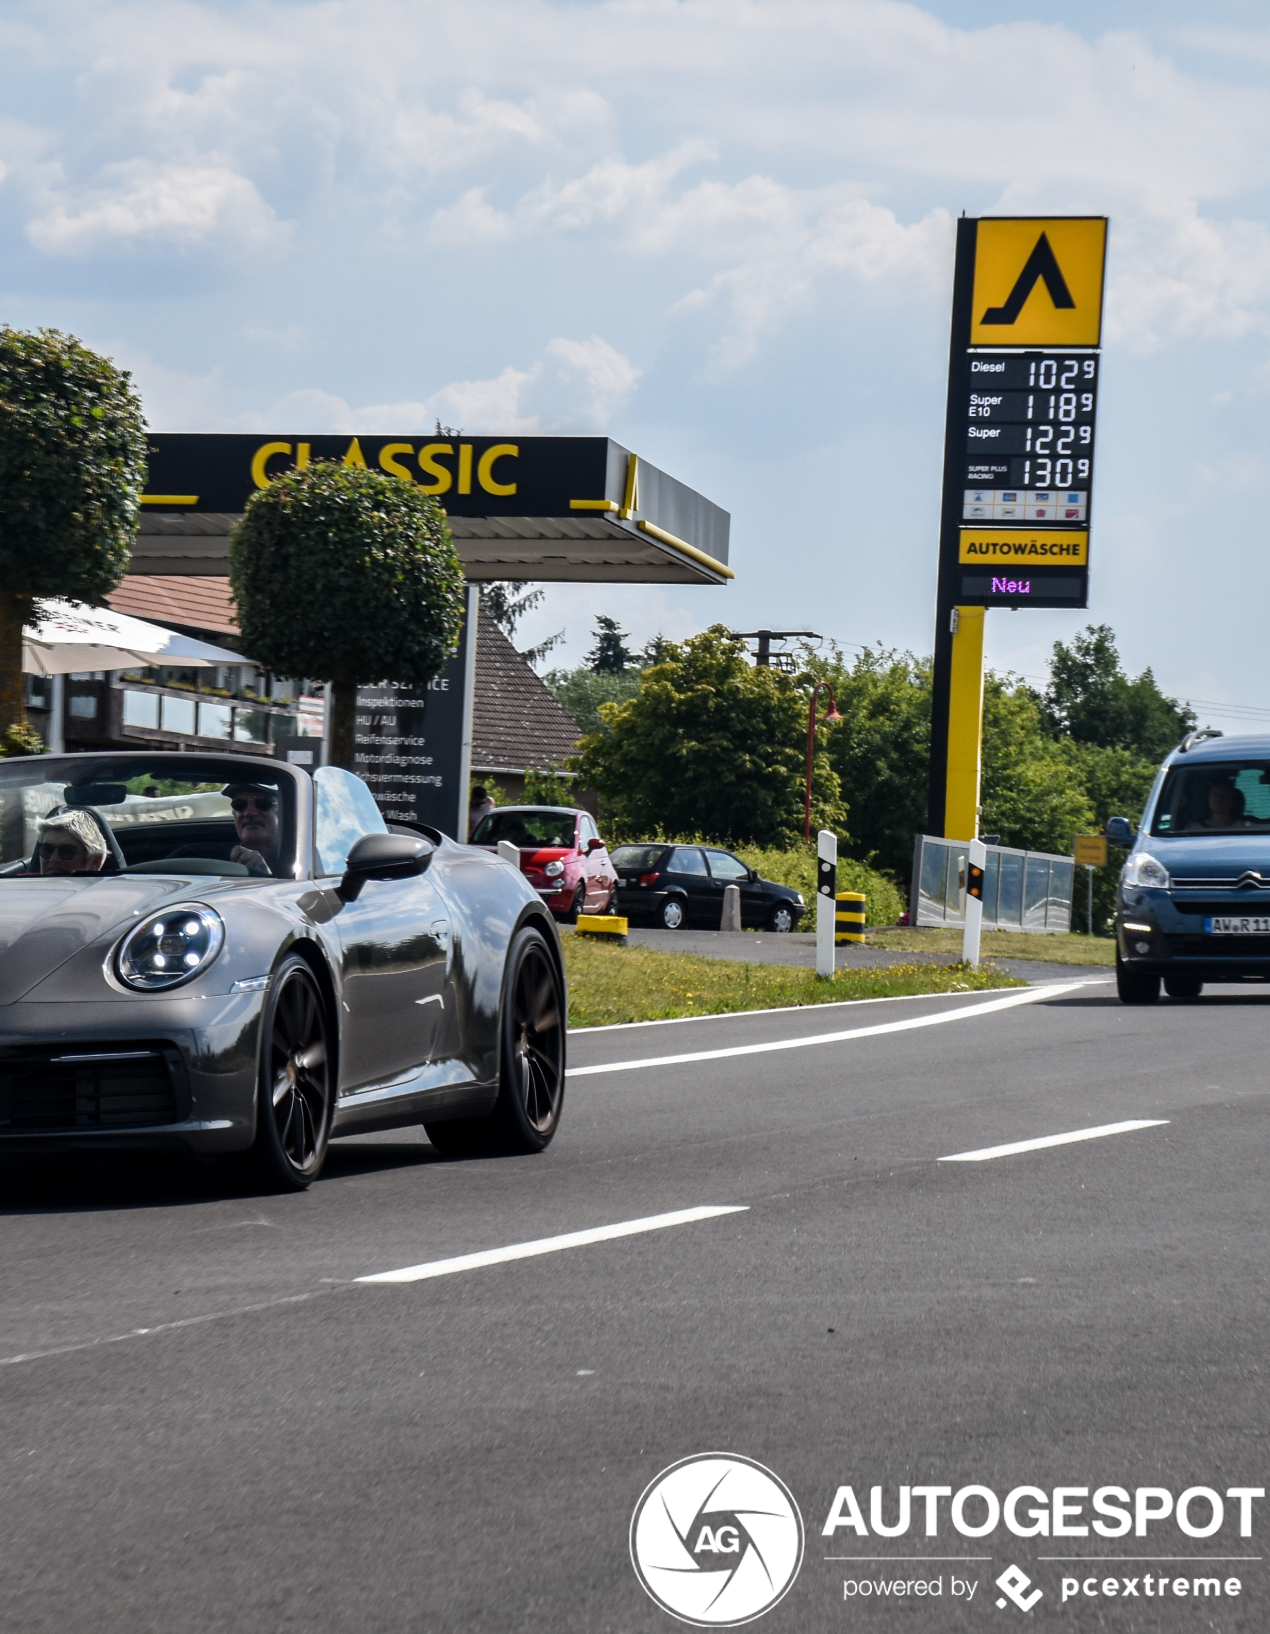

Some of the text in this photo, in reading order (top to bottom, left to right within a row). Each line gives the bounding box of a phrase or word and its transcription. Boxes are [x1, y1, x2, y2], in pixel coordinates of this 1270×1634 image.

[971, 361, 1005, 372] Diesel
[970, 395, 1003, 407] Super
[968, 407, 991, 417] E10
[968, 427, 1001, 438] Super
[967, 540, 1080, 556] AUTOWÄSCHE
[991, 577, 1030, 593] Neu
[356, 695, 424, 709] Inspektionen
[355, 714, 372, 726] HU
[380, 715, 397, 726] AU
[354, 733, 425, 746] Reifenservice
[354, 752, 433, 767] Motordiagnose
[385, 809, 417, 821] Wash
[1213, 918, 1232, 932] AW
[1241, 918, 1250, 932] R
